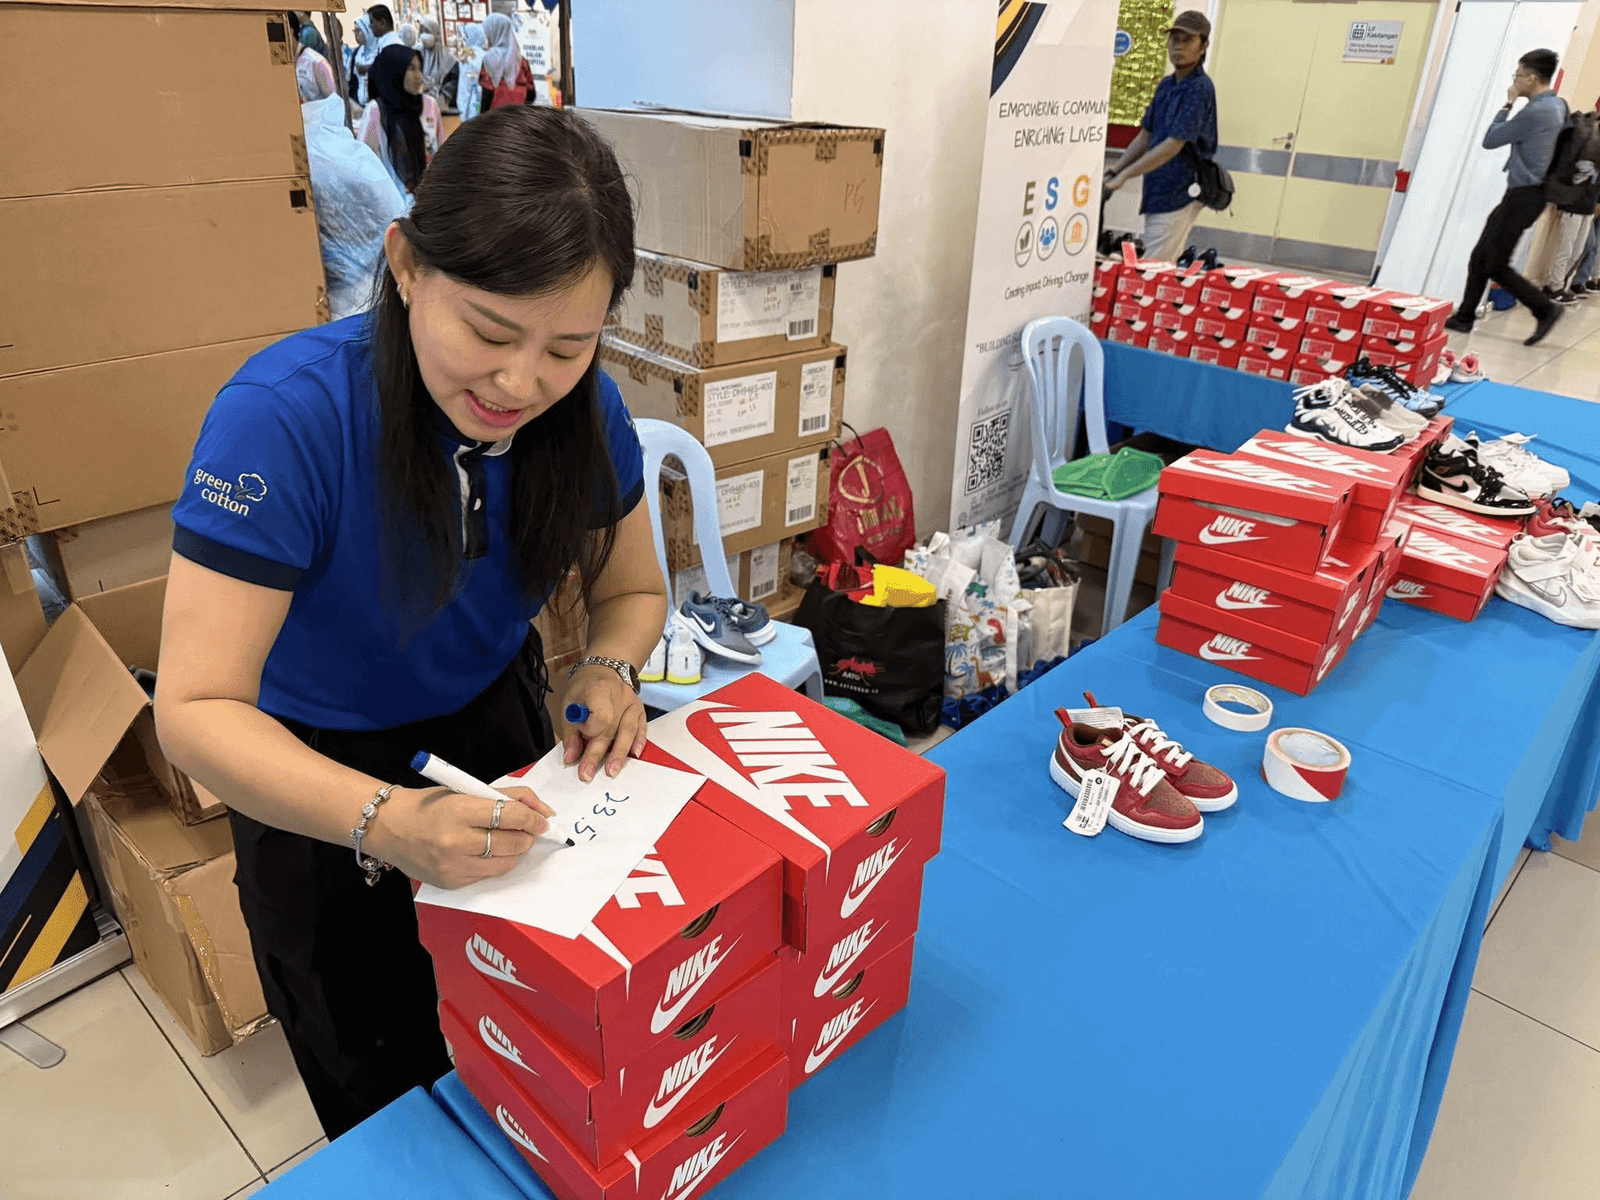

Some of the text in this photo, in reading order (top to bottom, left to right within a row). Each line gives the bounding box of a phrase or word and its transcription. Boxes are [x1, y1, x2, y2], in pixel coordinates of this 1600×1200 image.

[1023, 175, 1090, 216] E S G
[194, 468, 232, 494] green
[201, 488, 249, 516] cotton
[1209, 515, 1256, 538] NIKE
[1227, 581, 1271, 604] NIKE
[1394, 579, 1426, 595] NIKE
[1208, 633, 1252, 655] NIKE
[708, 711, 870, 811] NIKE
[851, 837, 897, 893] NIKE
[662, 934, 723, 1006] NIKE
[824, 918, 874, 974] NIKE
[815, 996, 865, 1051] NIKE
[656, 1034, 718, 1102] NIKE
[667, 1131, 727, 1198] NIKE
